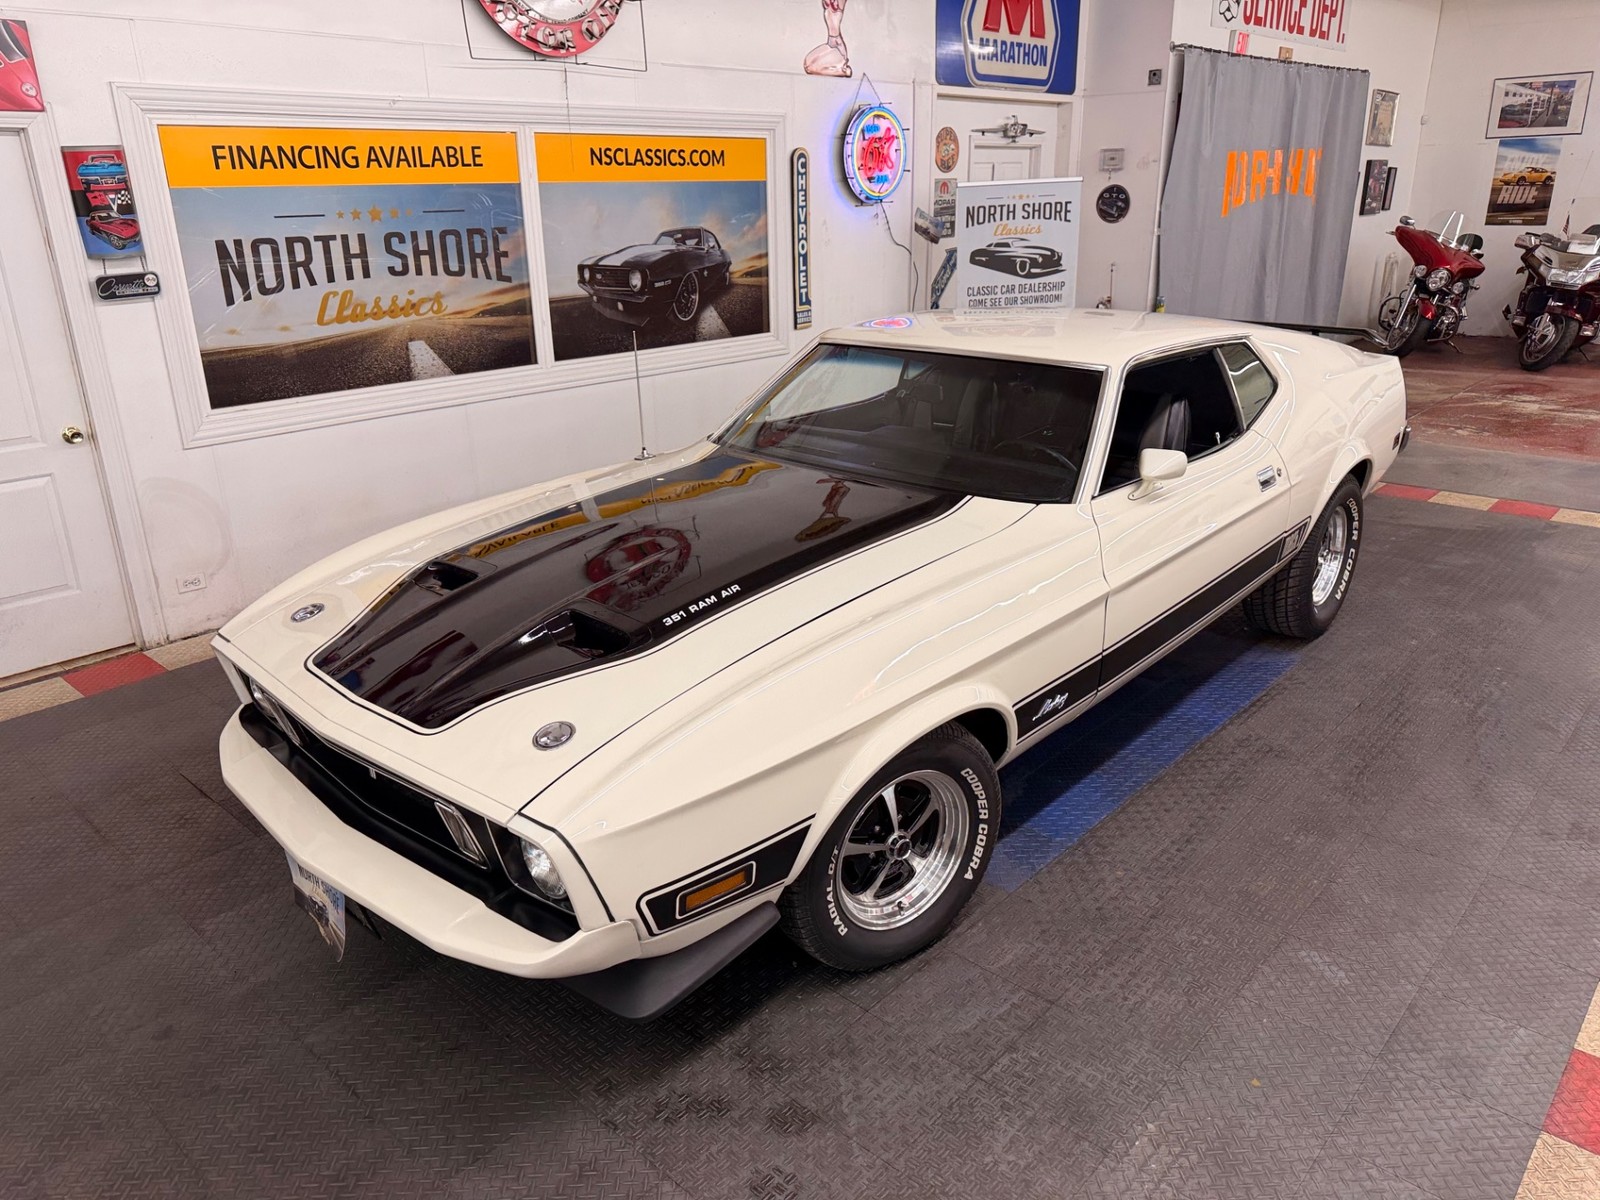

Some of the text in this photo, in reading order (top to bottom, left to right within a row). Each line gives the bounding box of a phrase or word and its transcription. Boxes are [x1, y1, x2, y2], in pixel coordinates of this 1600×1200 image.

[978, 37, 1048, 67] MARATHON
[211, 145, 484, 170] FINANCING AVAILABLE
[589, 147, 725, 167] NSCLASSICS.COM
[1497, 185, 1539, 204] RIDE
[966, 203, 1016, 228] NORTH
[1021, 201, 1072, 223] SHORE
[797, 158, 808, 302] CHEVROLET
[993, 223, 1043, 237] Classics
[215, 226, 513, 307] NORTH SHORE
[967, 281, 1066, 297] CLASSIC CAR DEALERSHIP
[968, 293, 1063, 308] COME SEE OUR SHOWROOM!
[316, 289, 448, 327] Classics
[1335, 498, 1359, 600] COOPER COBRA
[662, 584, 741, 626] 351 RAM AIR
[960, 767, 989, 880] COOPER COBRA
[826, 881, 849, 937] RADIAL
